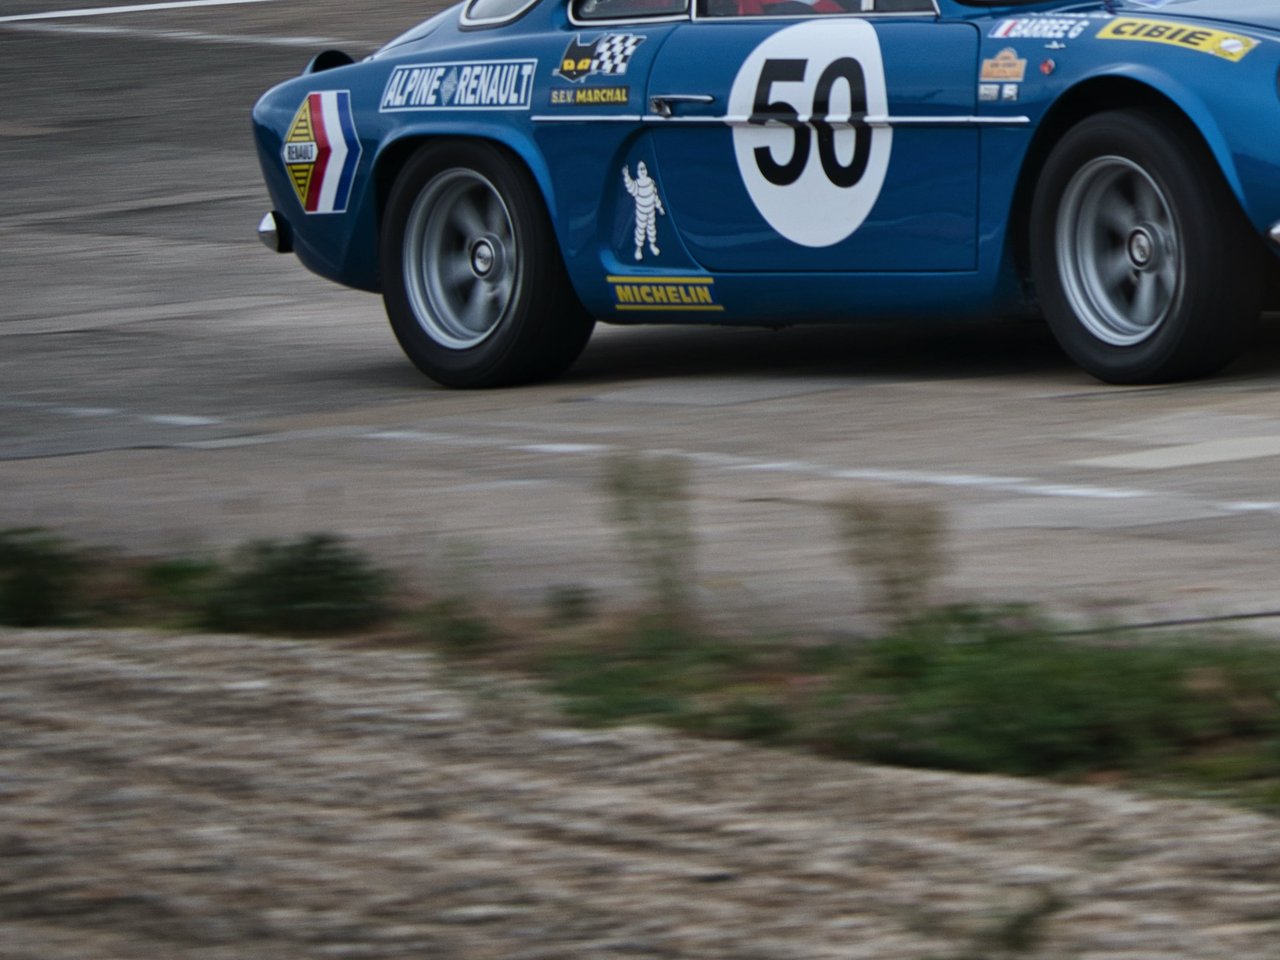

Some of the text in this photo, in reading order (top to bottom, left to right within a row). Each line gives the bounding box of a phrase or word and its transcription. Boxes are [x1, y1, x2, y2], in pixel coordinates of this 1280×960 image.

[1111, 22, 1214, 47] CIBIE
[383, 63, 535, 107] ALPINE RENAULT
[576, 88, 628, 103] MARCHAL
[748, 56, 874, 189] 50
[287, 143, 314, 161] RENAULT
[615, 284, 713, 304] MICHELIN
